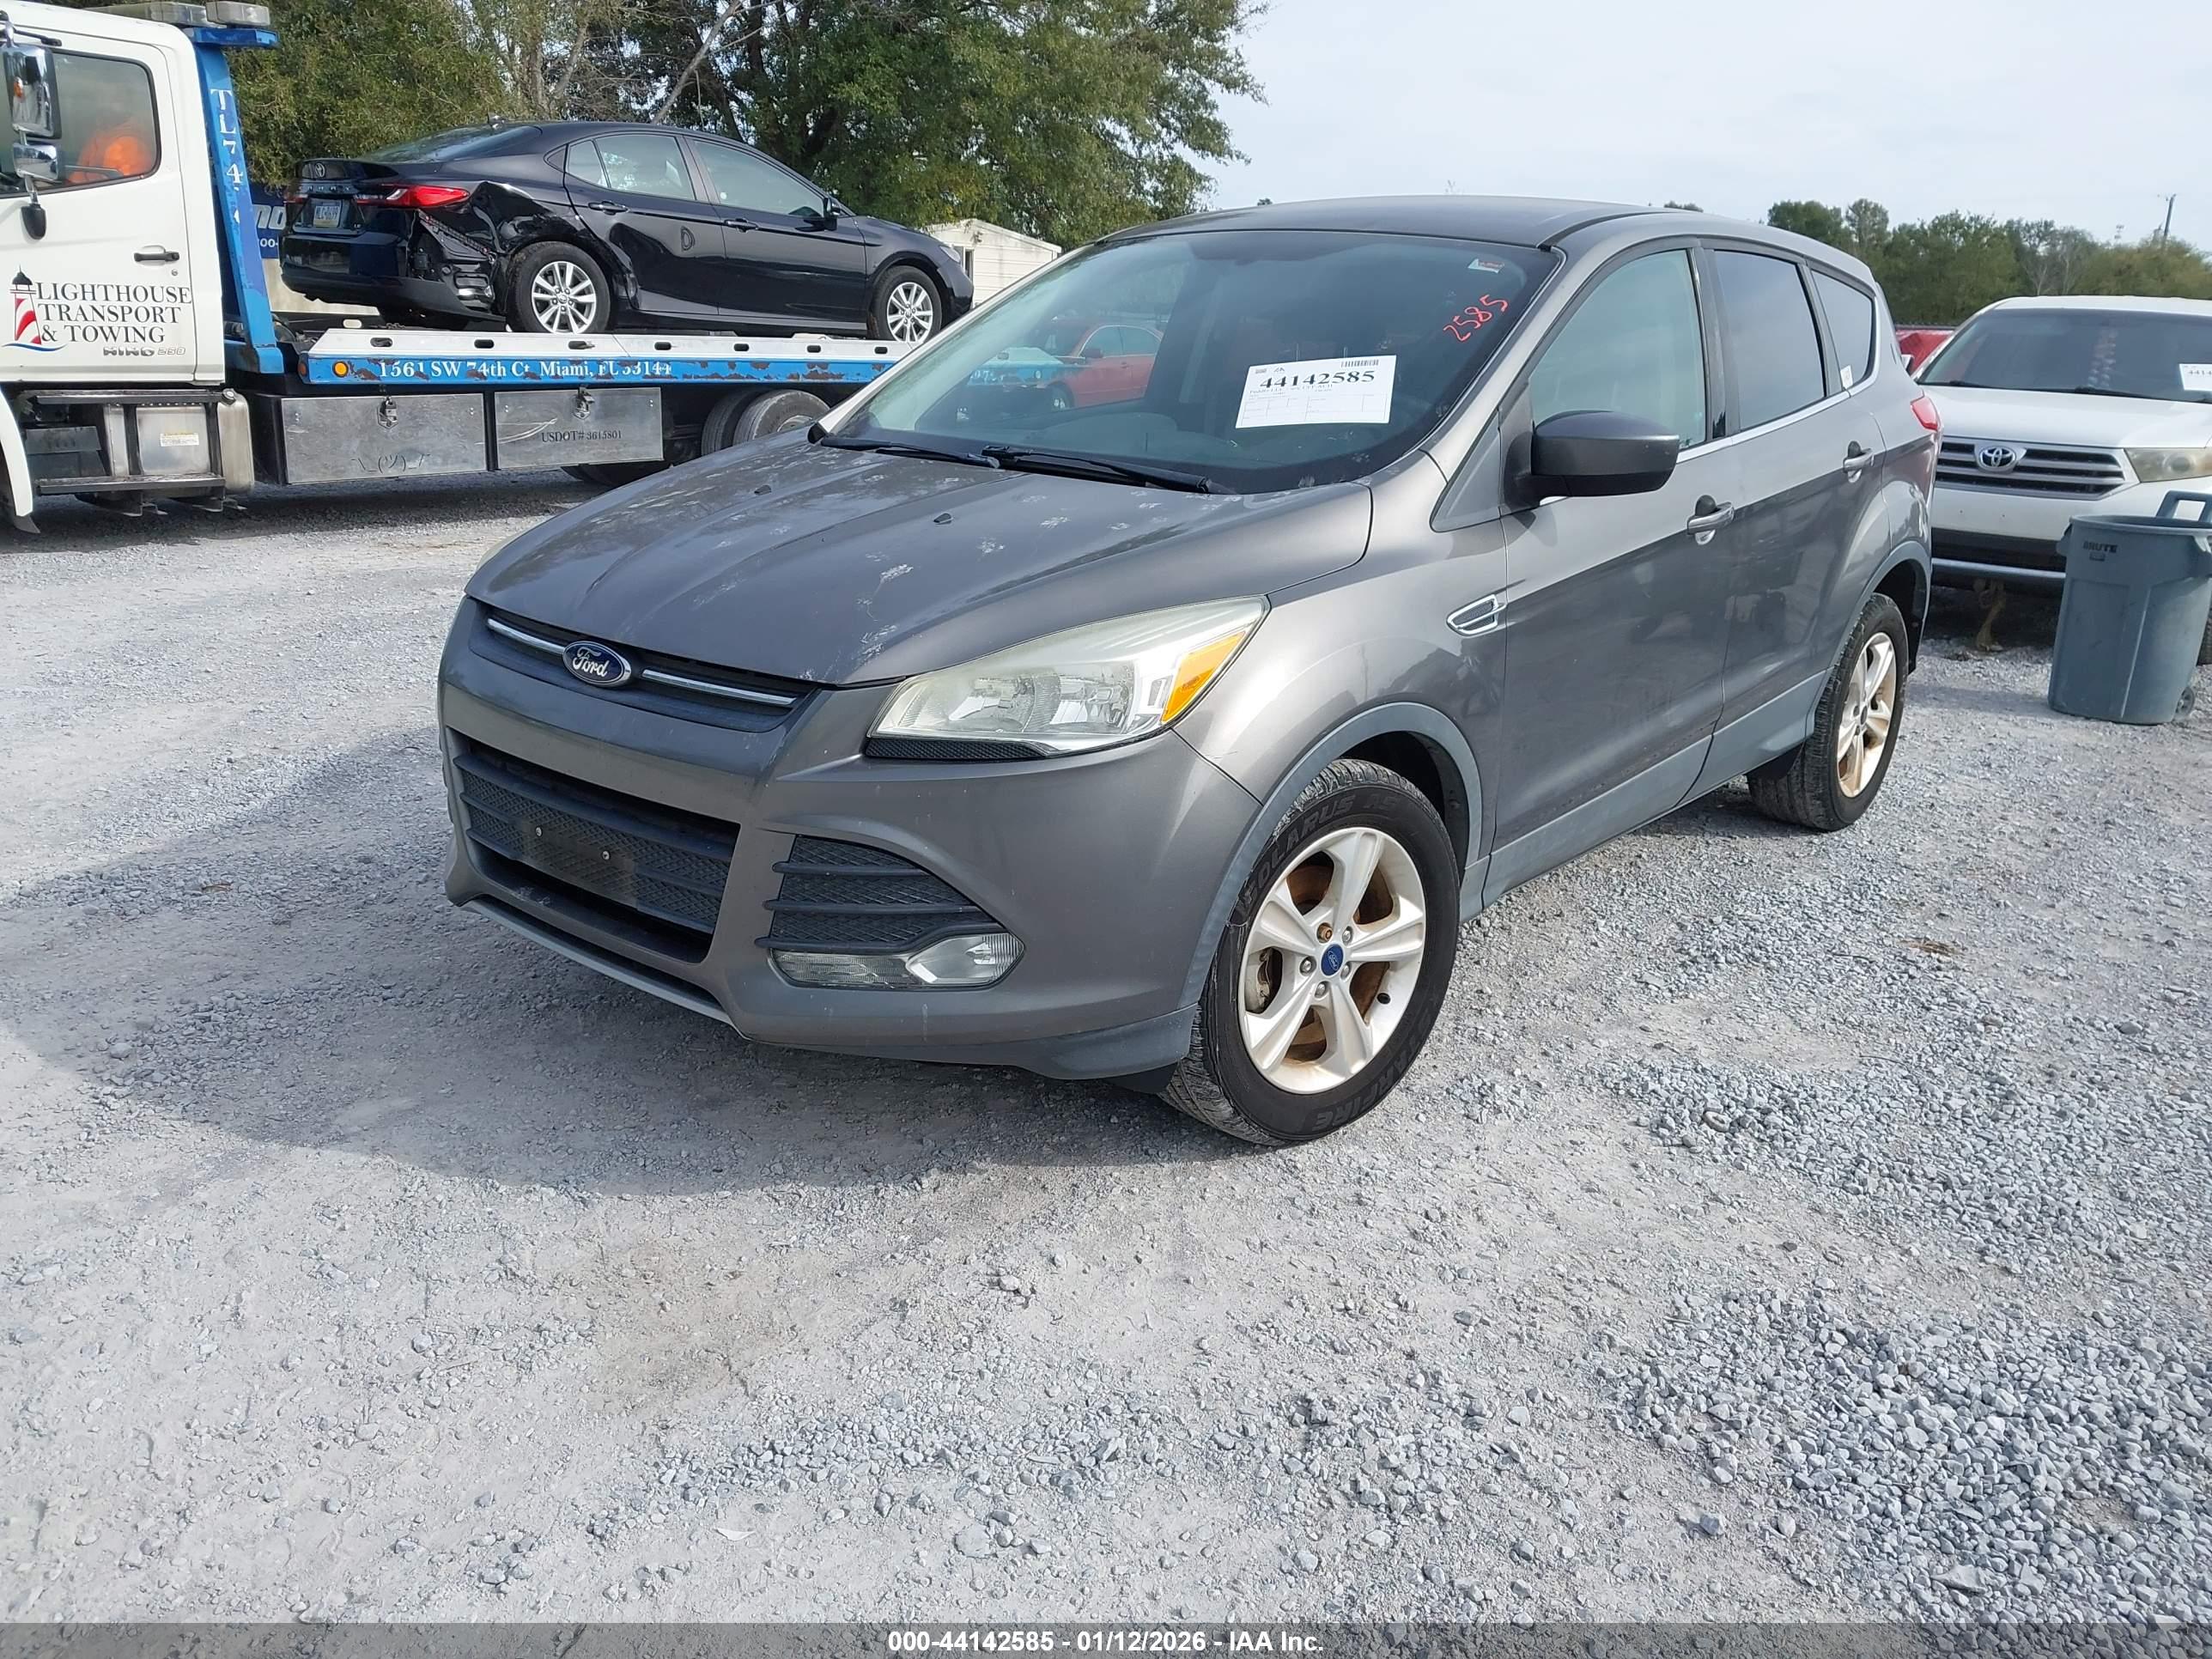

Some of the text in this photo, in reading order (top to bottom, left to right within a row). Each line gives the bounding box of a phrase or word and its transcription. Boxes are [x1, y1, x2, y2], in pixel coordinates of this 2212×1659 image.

[35, 282, 192, 304] LIGHTHOUSE
[38, 303, 181, 323] TRANSPORT
[1443, 294, 1509, 342] 2585
[41, 325, 166, 343] & TOWING
[430, 361, 461, 378] SW
[539, 361, 594, 377] Miami,
[1260, 370, 1375, 388] 44142585
[542, 430, 584, 442] USDOT#
[572, 647, 610, 678] Ford
